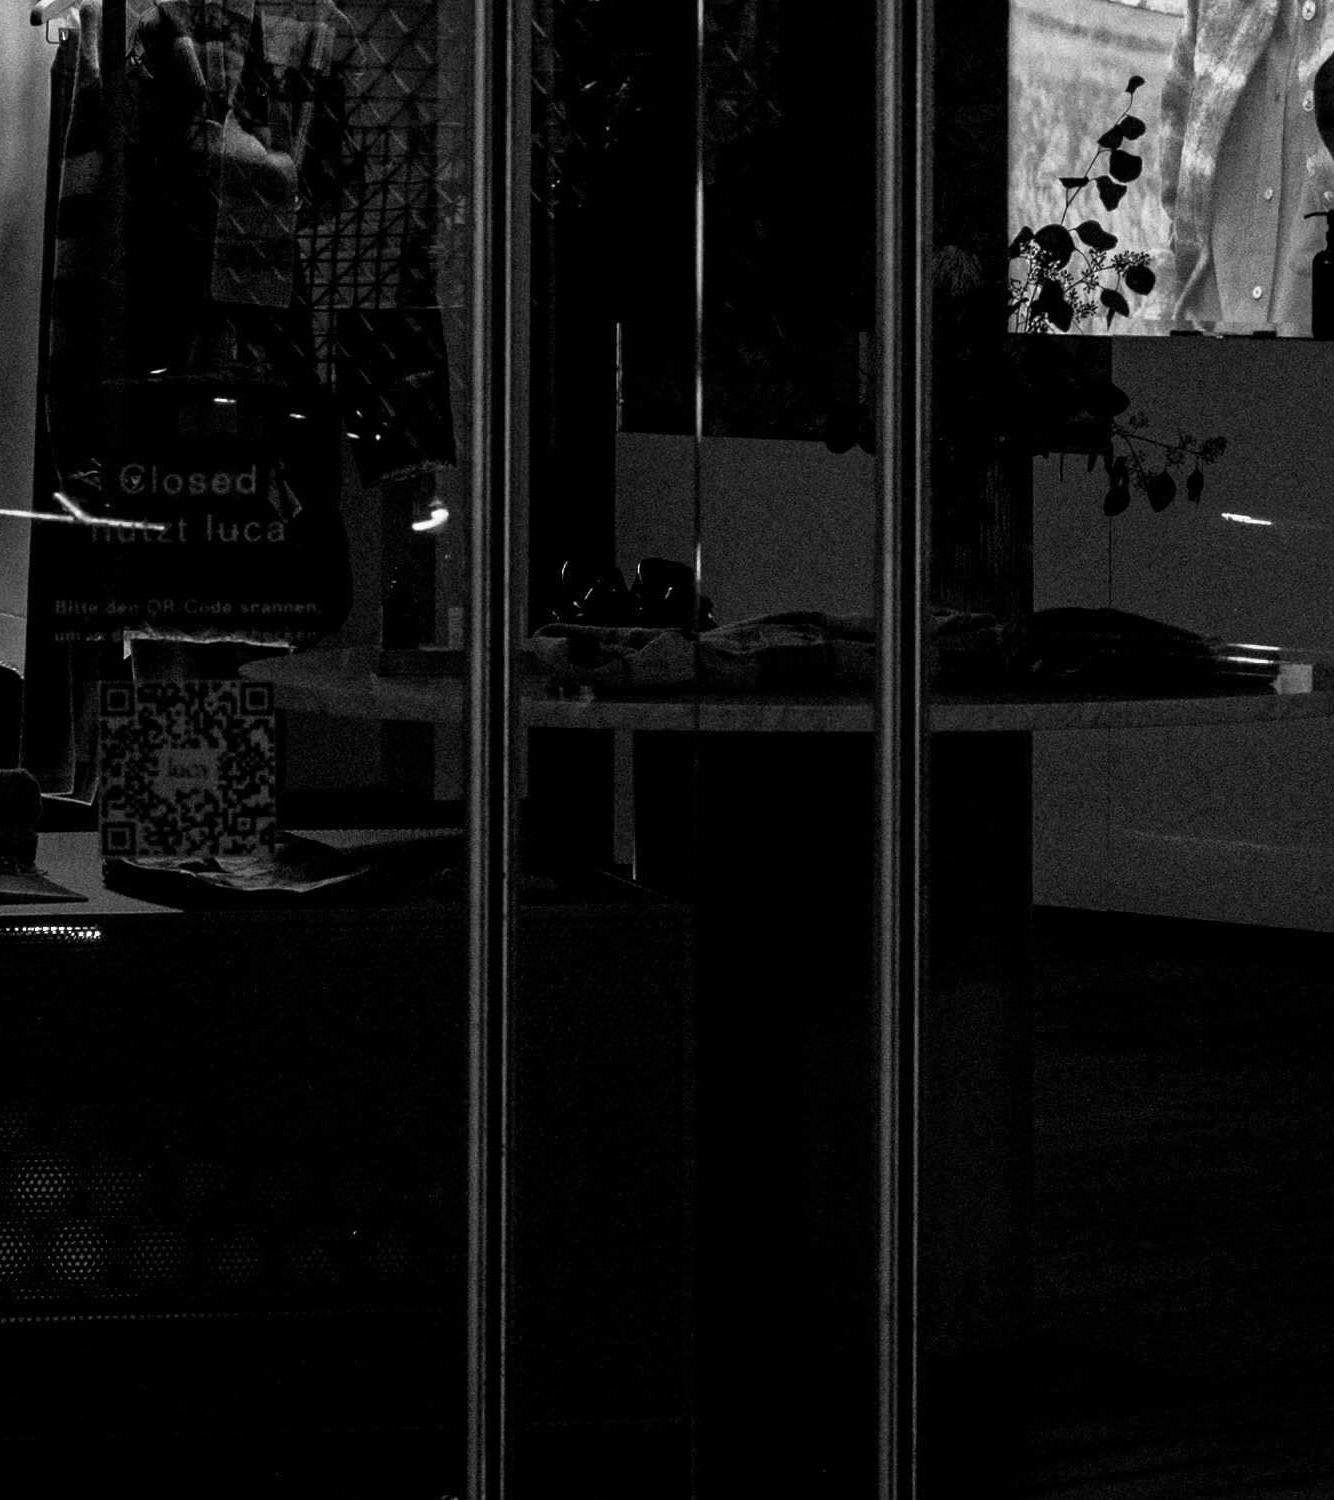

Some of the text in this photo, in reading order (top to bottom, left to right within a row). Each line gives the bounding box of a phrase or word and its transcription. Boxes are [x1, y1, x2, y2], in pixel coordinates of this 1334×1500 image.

[118, 462, 258, 495] Closed
[90, 512, 287, 544] nutzt luca
[54, 598, 99, 616] Bitte
[105, 598, 140, 616] den
